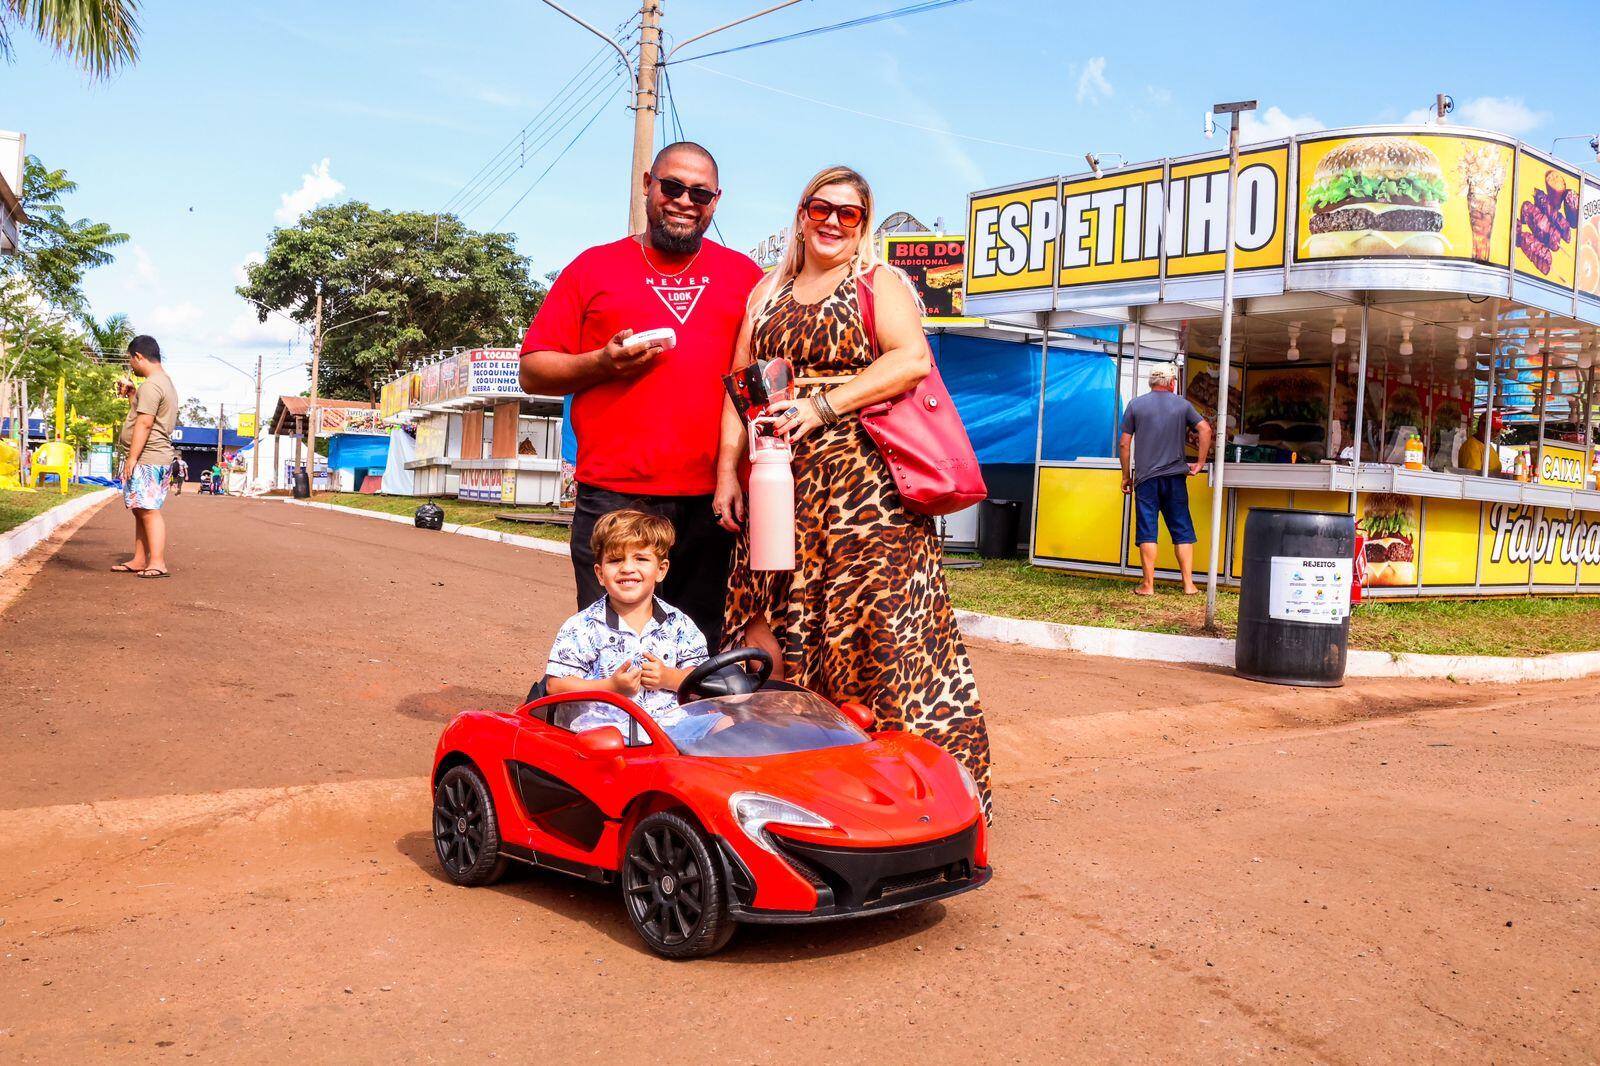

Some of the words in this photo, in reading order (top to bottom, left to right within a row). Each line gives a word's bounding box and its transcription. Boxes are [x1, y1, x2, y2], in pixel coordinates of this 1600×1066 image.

[972, 163, 1279, 278] ESPETINHO
[896, 243, 928, 256] BIG
[935, 243, 964, 256] DO
[646, 276, 710, 285] NEVER
[668, 292, 692, 301] LOOK
[1541, 454, 1582, 484] CAIXA
[1490, 502, 1600, 565] Fábrica
[1303, 560, 1336, 568] REJEITOS
